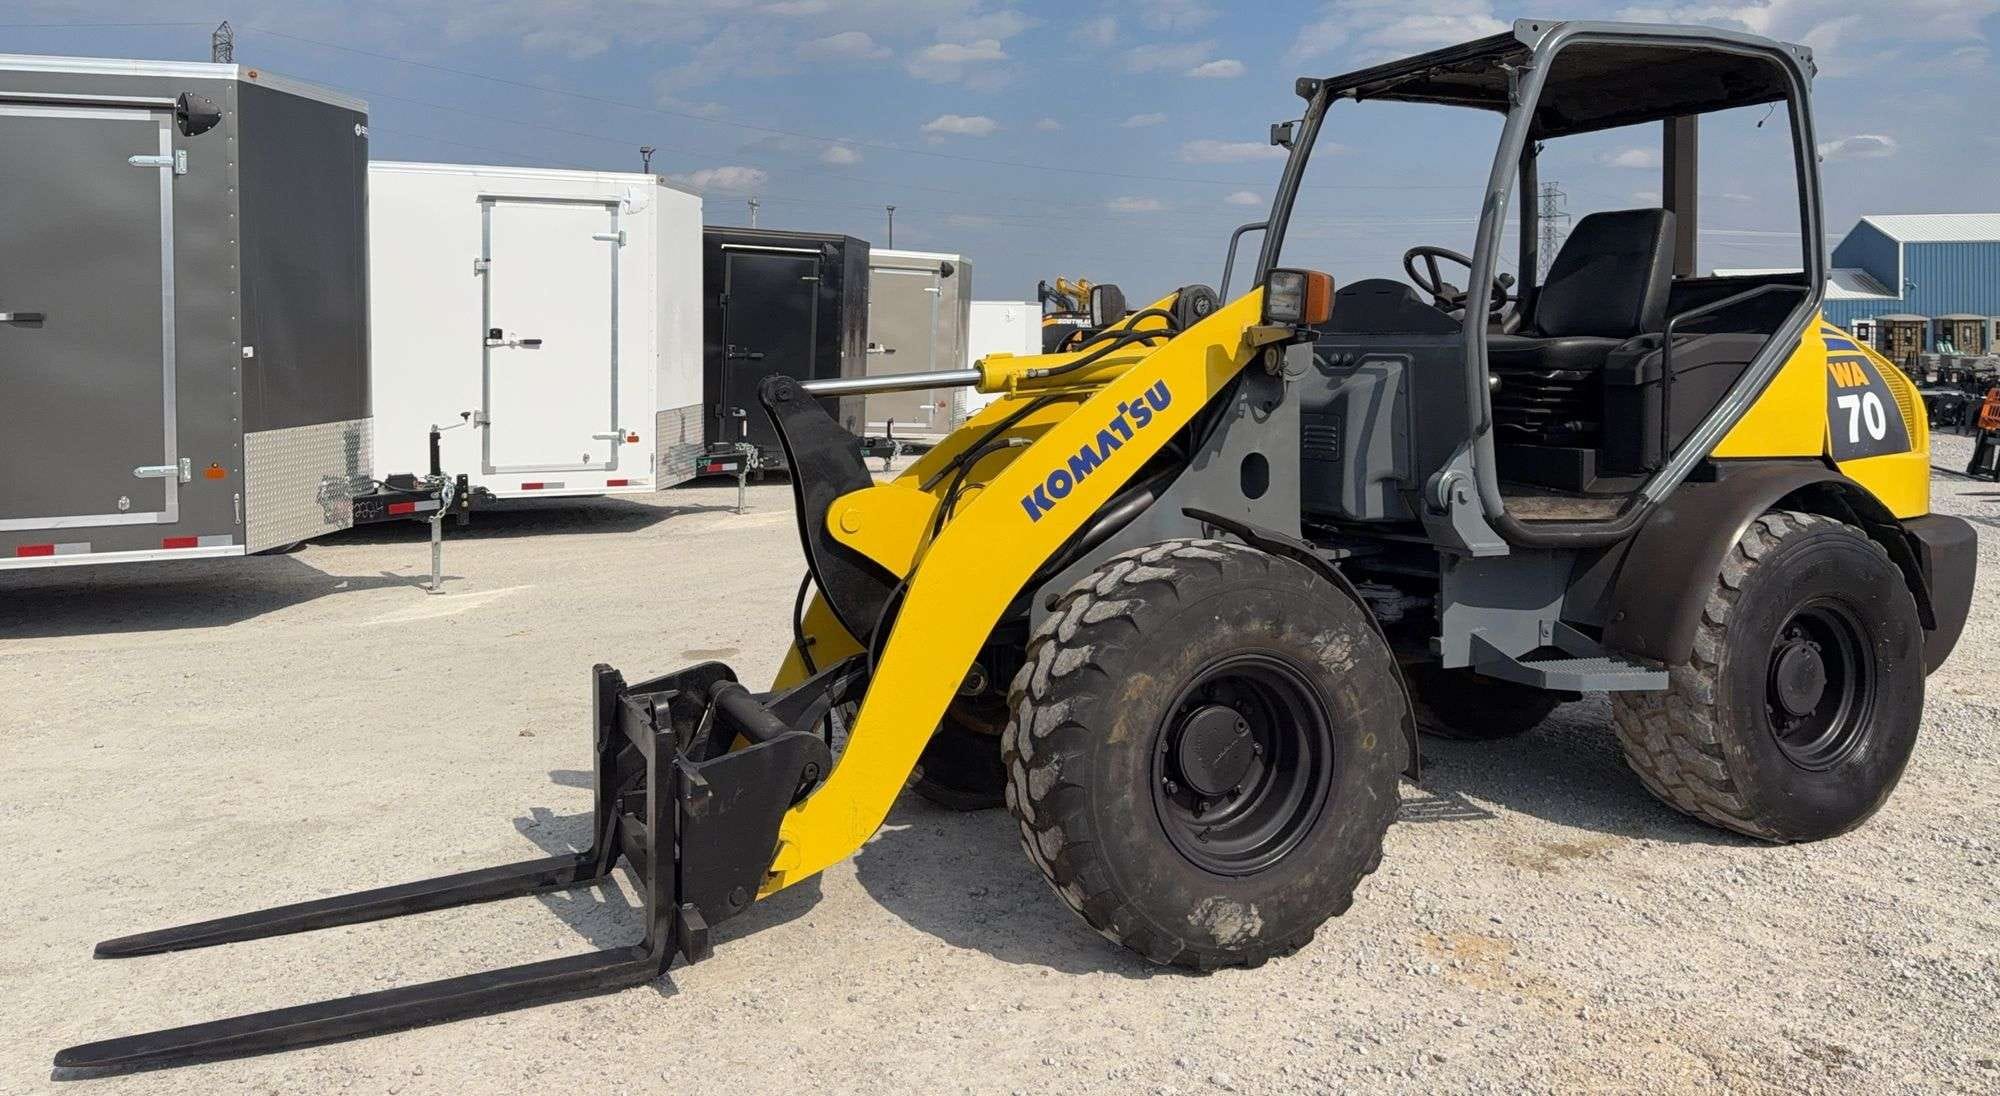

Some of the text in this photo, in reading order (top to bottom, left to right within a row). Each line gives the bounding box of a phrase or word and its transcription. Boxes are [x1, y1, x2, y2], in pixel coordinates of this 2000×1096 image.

[1828, 361, 1870, 388] WA
[1837, 391, 1887, 443] 70
[1020, 379, 1172, 523] KOMATSU
